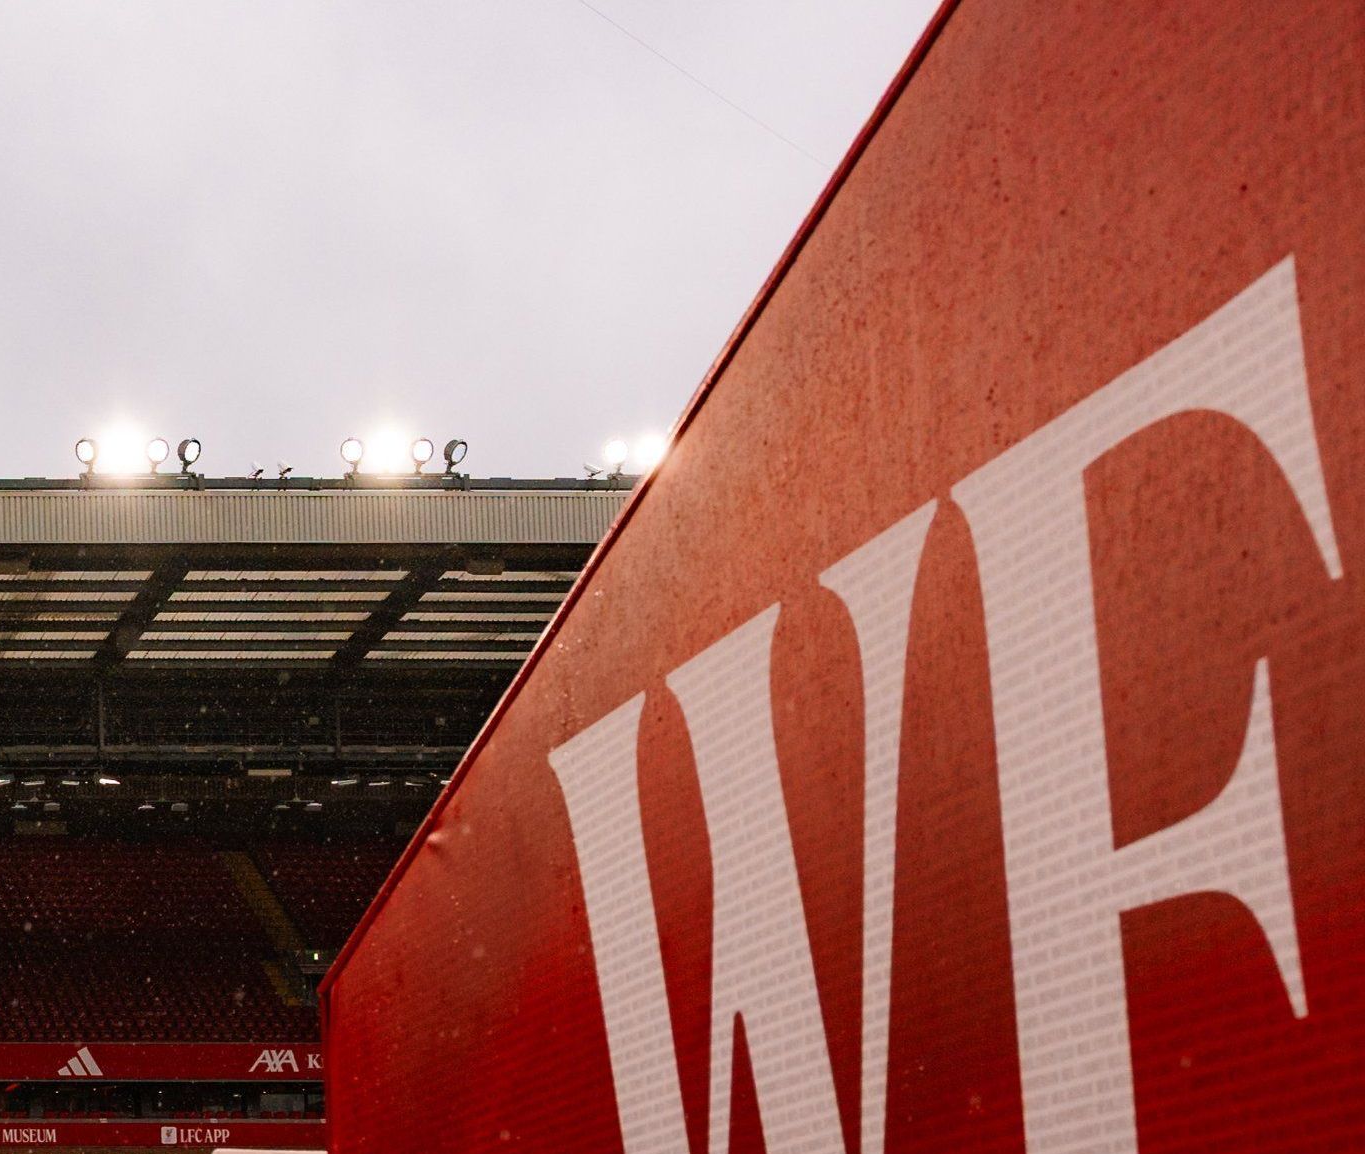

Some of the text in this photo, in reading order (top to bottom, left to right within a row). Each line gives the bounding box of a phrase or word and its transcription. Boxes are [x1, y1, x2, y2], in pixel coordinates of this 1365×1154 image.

[248, 1049, 300, 1073] AXA
[2, 1128, 57, 1143] MUSEUM
[180, 1128, 230, 1143] LFC APP
